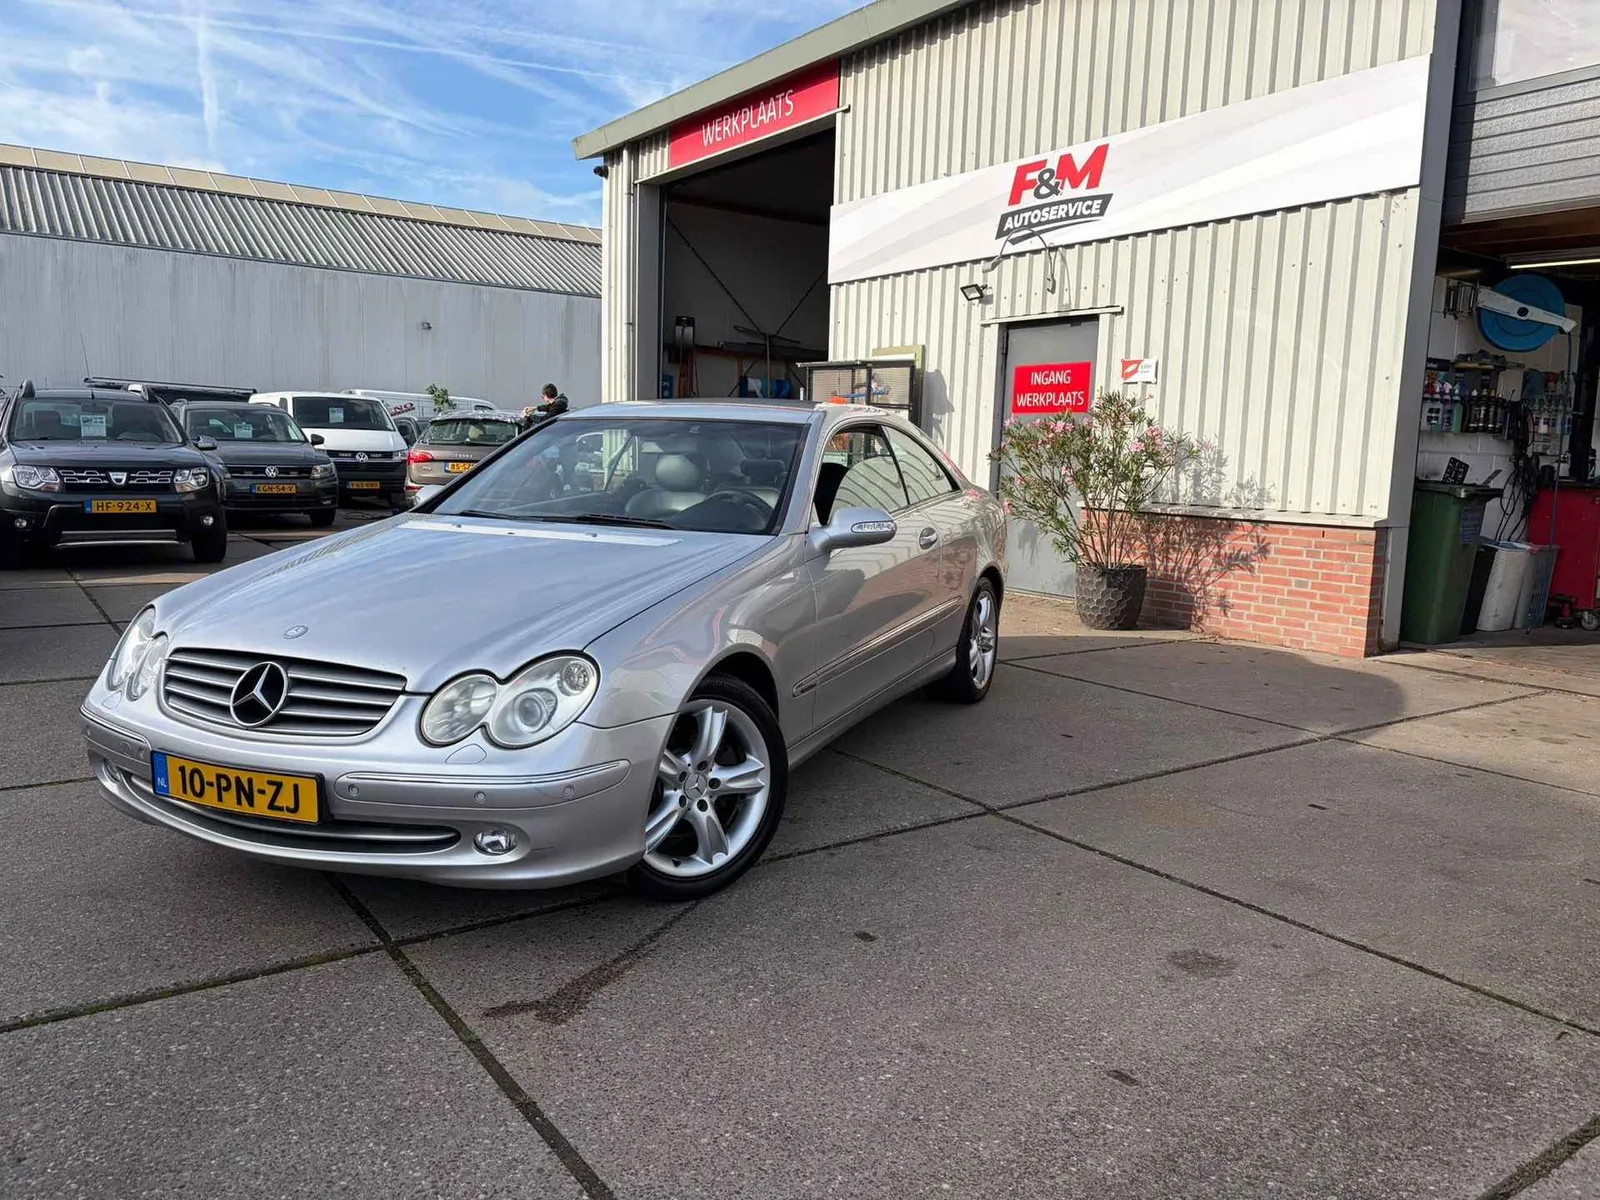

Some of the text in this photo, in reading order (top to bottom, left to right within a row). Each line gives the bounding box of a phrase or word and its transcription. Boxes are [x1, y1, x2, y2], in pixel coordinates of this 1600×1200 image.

[702, 89, 795, 147] WERKPLAATS
[1008, 143, 1110, 206] F&M
[1003, 199, 1103, 231] AUTOSERVICE
[1030, 369, 1072, 386] INGANG
[1016, 390, 1085, 407] WERKPLAATS
[96, 501, 152, 512] HF-924-X
[157, 765, 301, 814] NL 10-PN-ZJ
